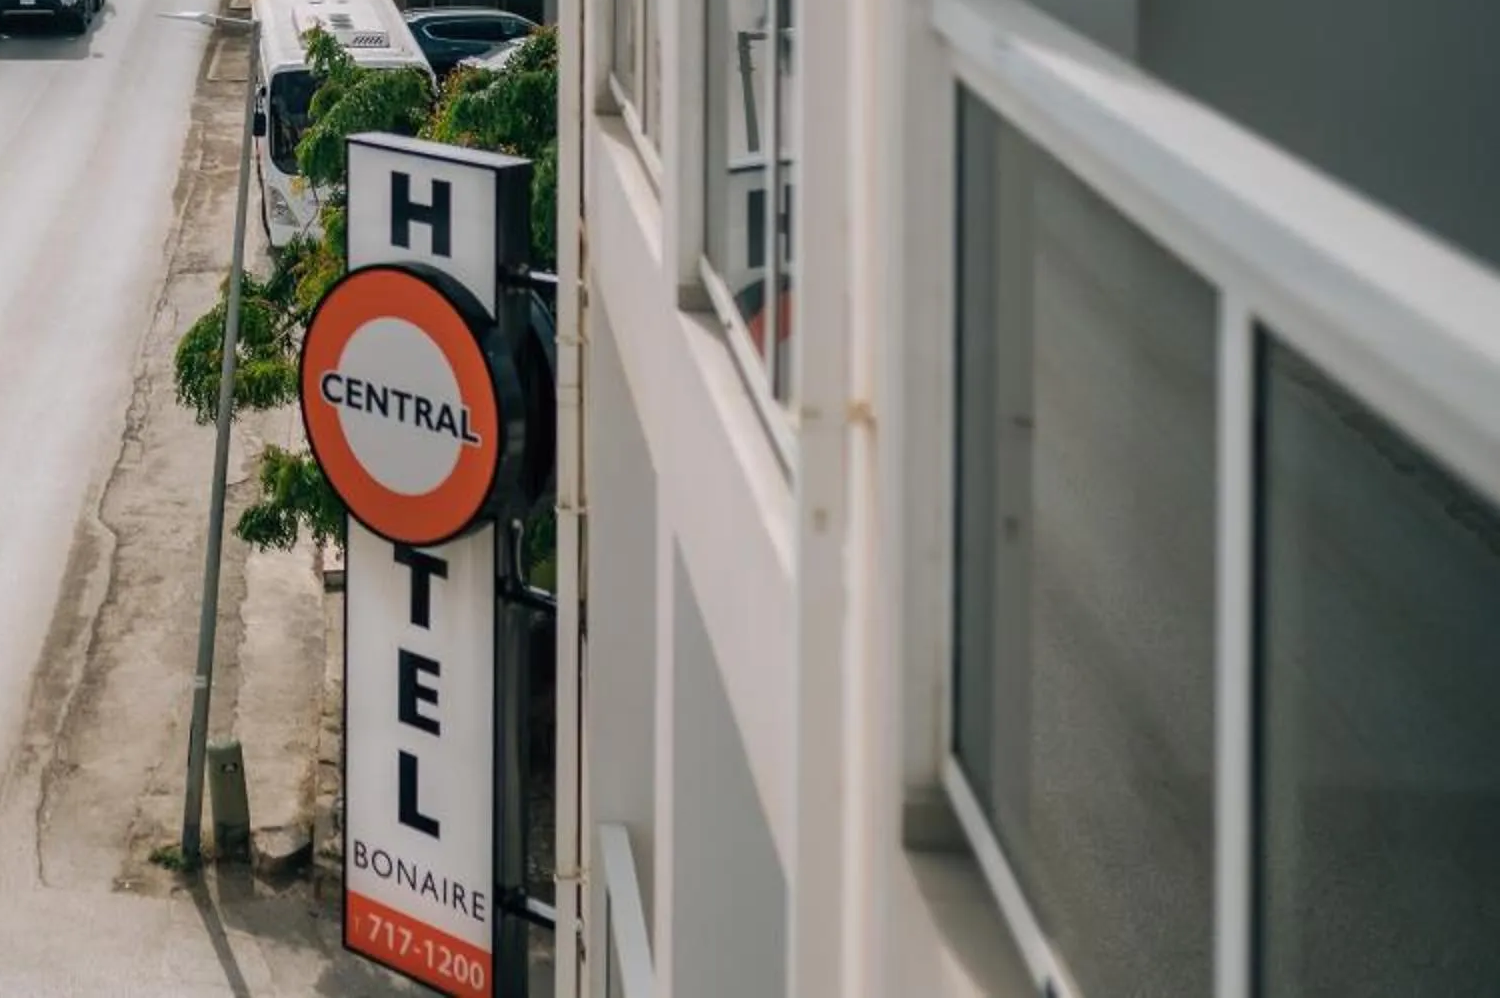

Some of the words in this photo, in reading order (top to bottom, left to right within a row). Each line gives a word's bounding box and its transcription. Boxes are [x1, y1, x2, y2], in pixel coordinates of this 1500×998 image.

[321, 372, 479, 444] CENTRAL
[353, 840, 486, 922] BONAIRE
[367, 912, 485, 989] 717-1200
